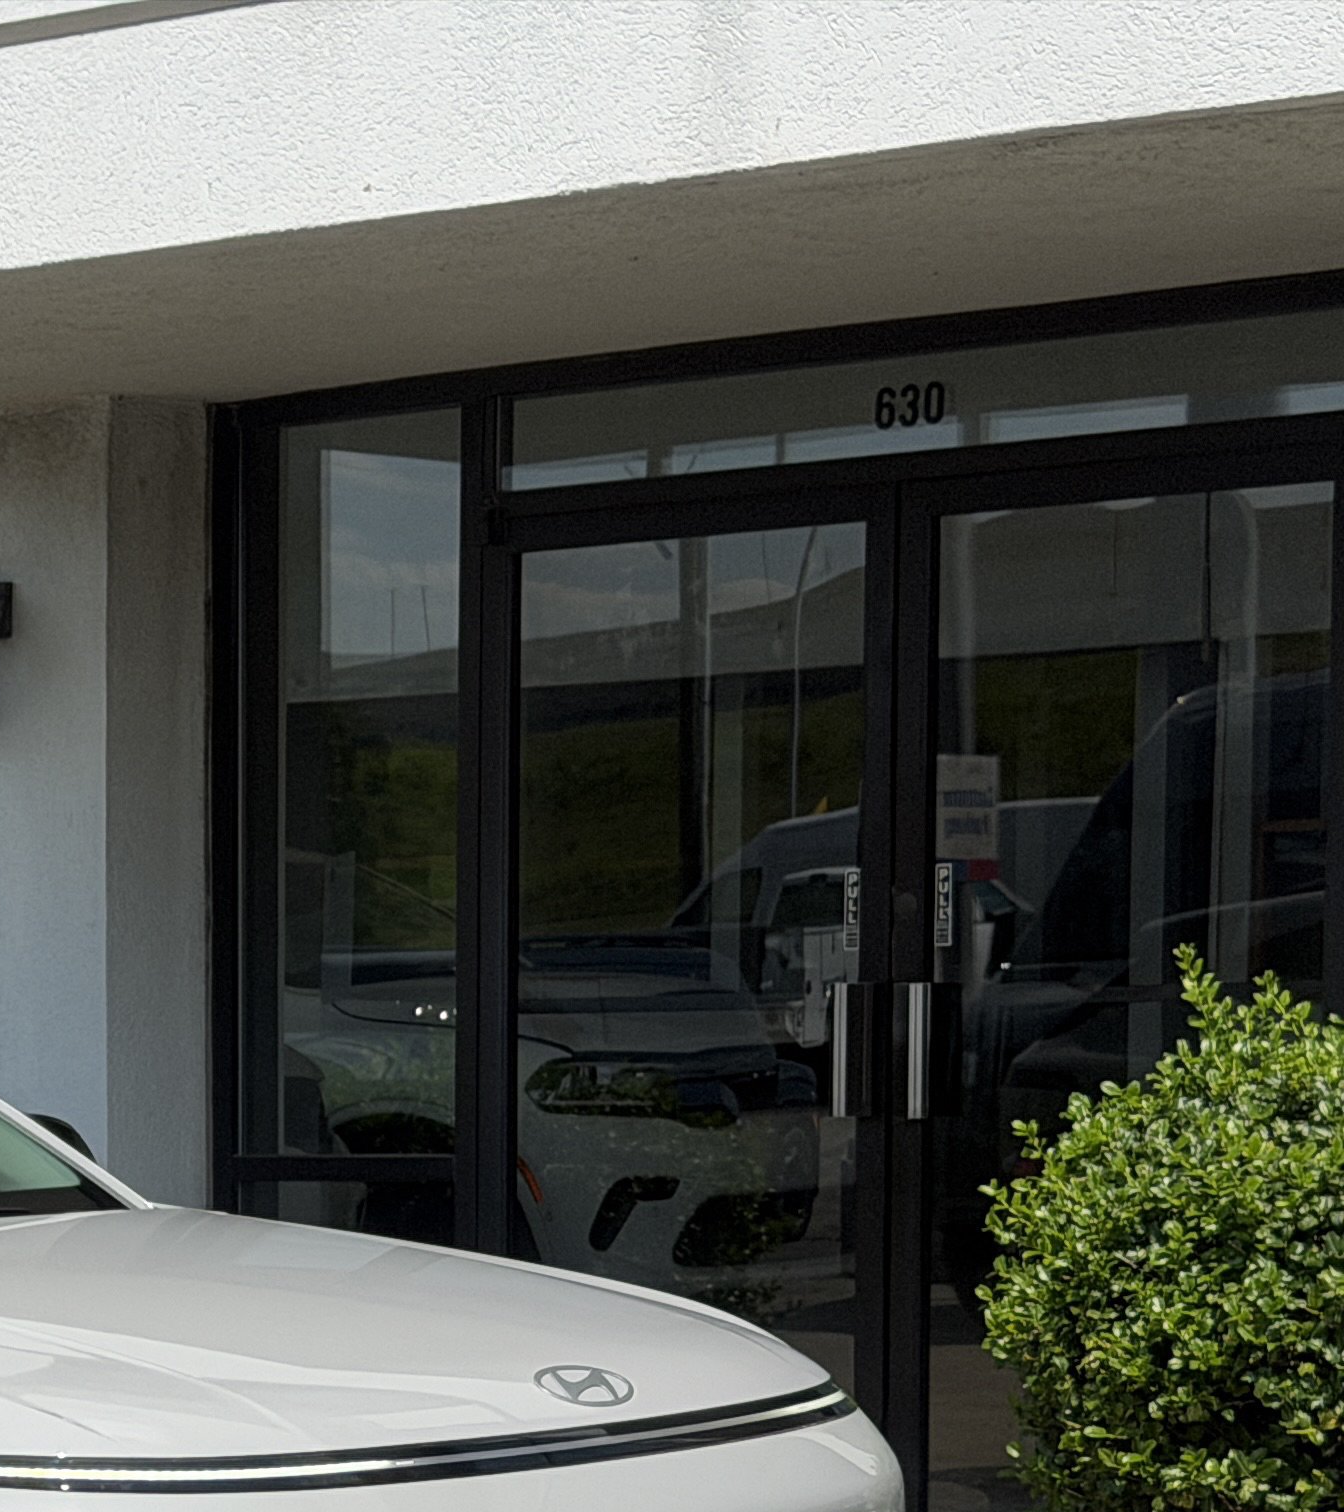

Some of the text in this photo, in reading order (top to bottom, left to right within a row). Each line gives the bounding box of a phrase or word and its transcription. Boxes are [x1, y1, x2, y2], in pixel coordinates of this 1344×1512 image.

[874, 381, 946, 430] 630
[848, 873, 859, 924] PULL
[938, 868, 949, 920] PULL
